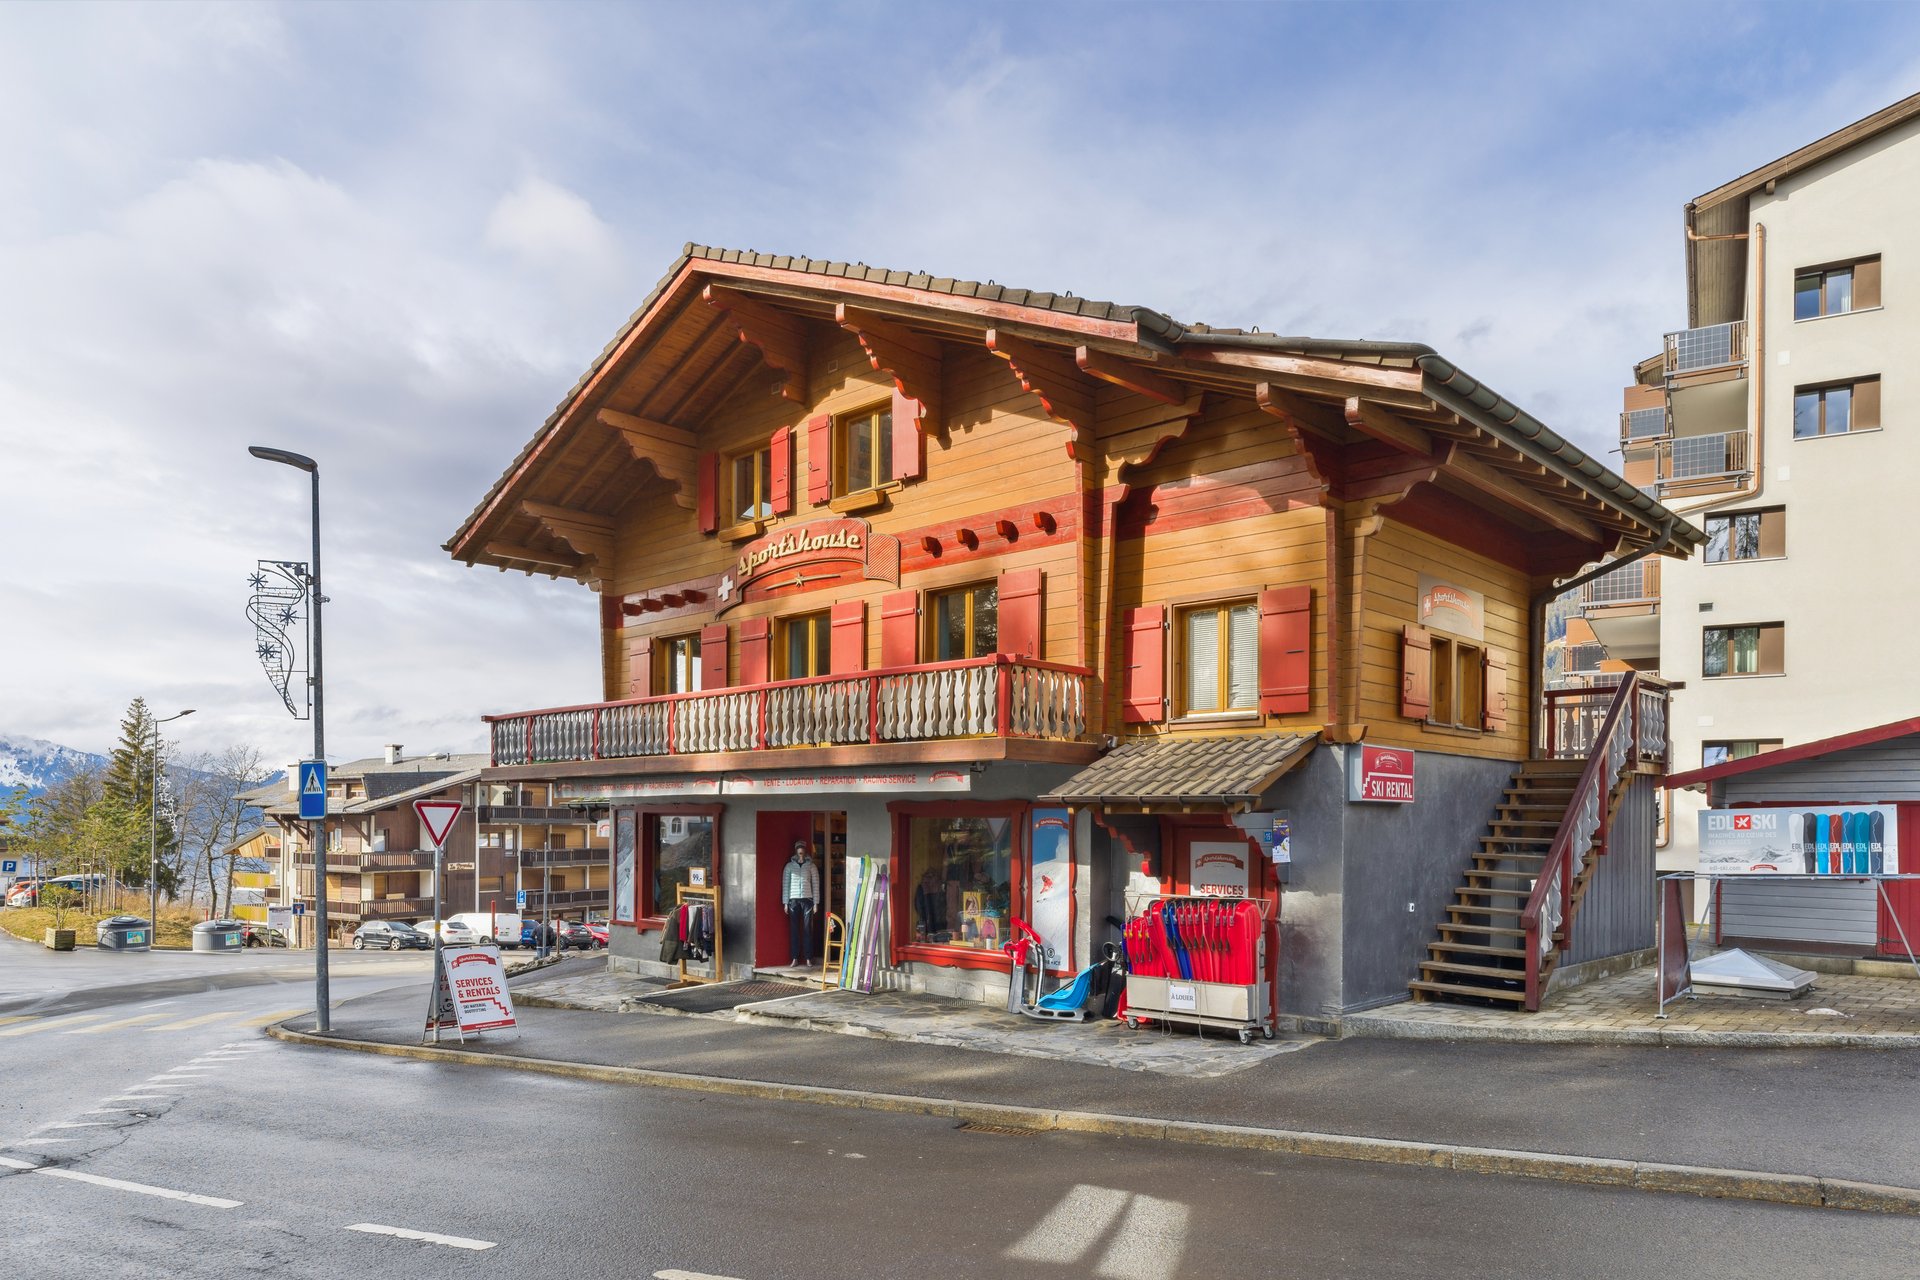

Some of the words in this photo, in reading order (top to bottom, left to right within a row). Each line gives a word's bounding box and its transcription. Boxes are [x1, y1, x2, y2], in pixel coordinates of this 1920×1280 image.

[764, 777, 781, 787] VENTE
[785, 776, 814, 787] LOCATION
[863, 774, 888, 784] RACING
[888, 773, 917, 784] SERVICE
[1371, 780, 1384, 797] SKI
[1386, 781, 1413, 799] RENTAL
[1708, 814, 1734, 831] EDL
[1751, 813, 1776, 830] SKI
[6, 862, 14, 871] P
[1200, 883, 1244, 895] SERVICES
[455, 976, 493, 988] SERVICES
[457, 989, 464, 998] &
[465, 986, 501, 998] RENTALS
[1175, 994, 1194, 1002] LOUER
